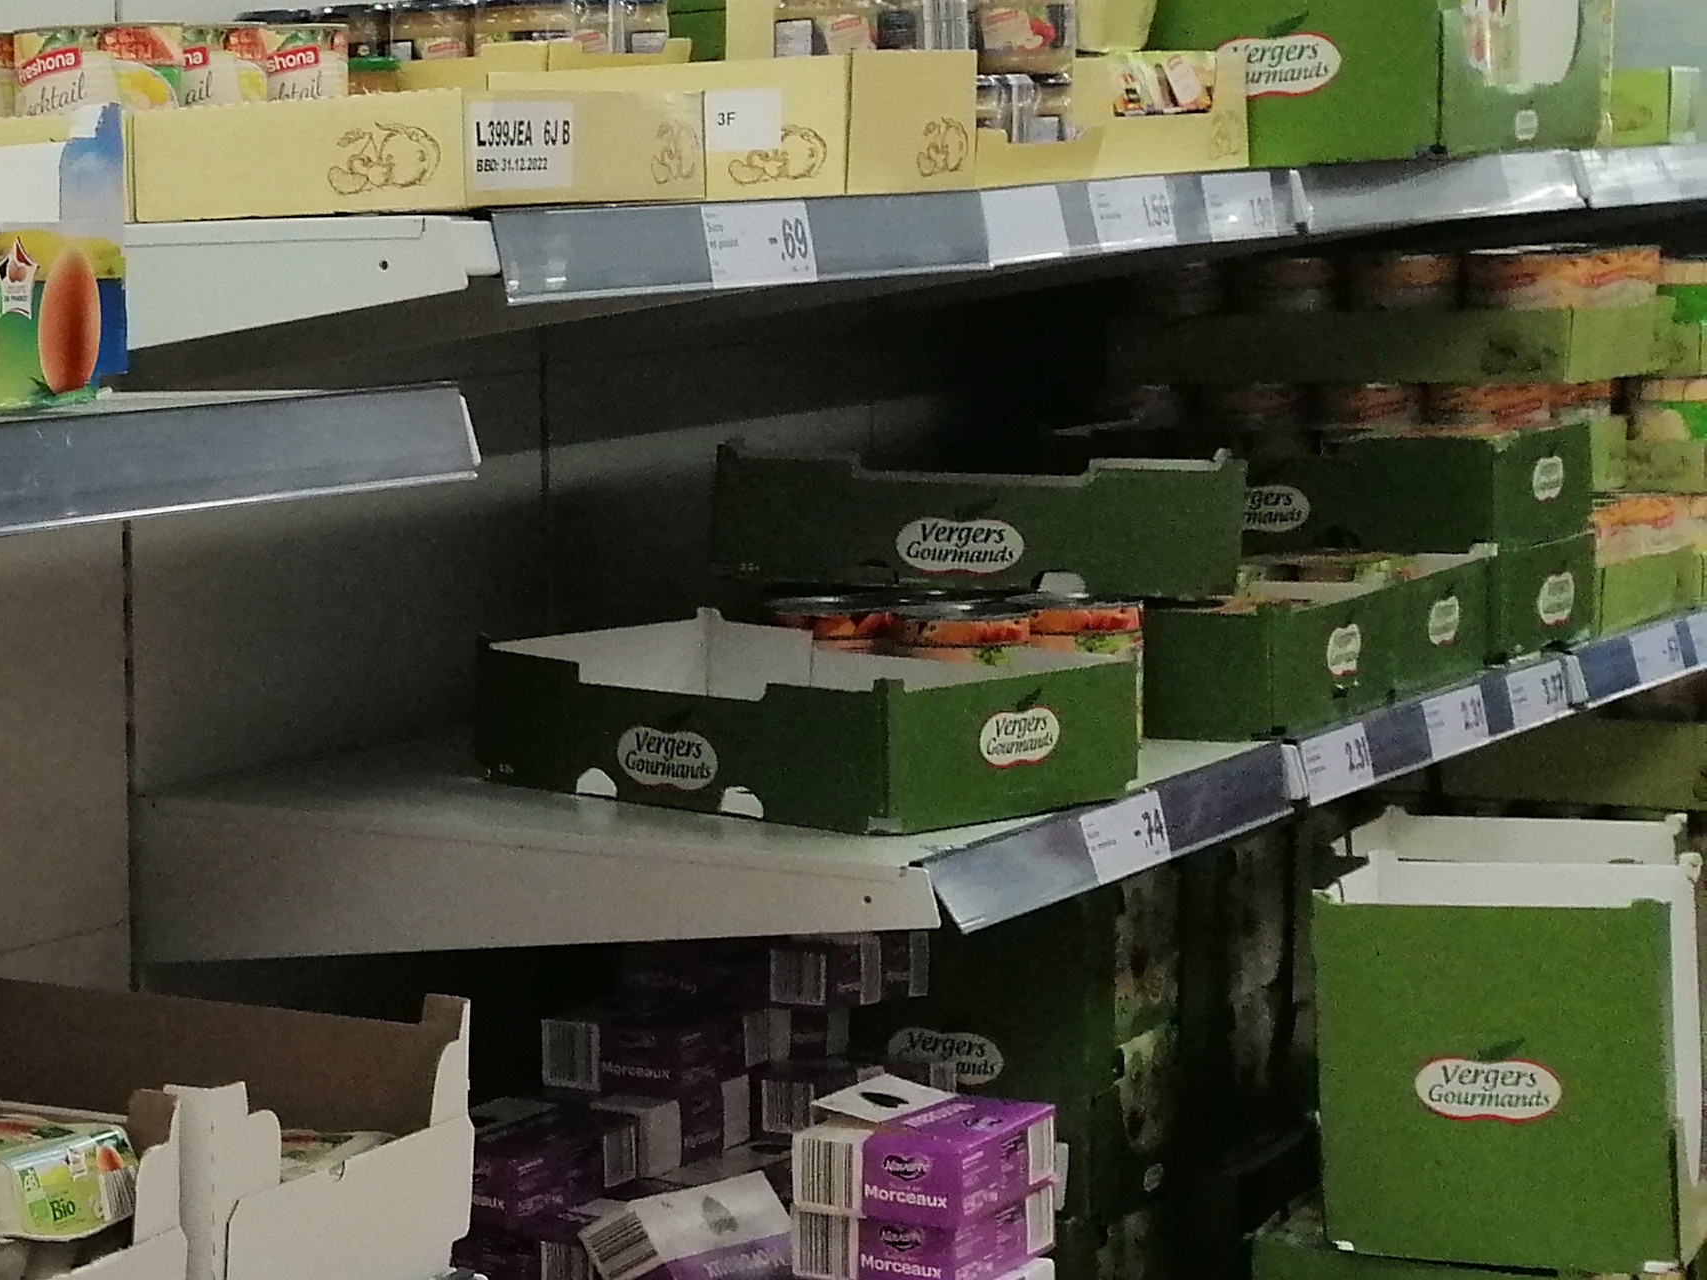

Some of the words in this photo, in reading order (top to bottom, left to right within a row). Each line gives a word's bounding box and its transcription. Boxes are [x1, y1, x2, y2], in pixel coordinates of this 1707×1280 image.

[718, 111, 737, 126] 3F
[768, 218, 808, 261] -.69
[919, 521, 1006, 552] Vergers
[905, 540, 1016, 566] Gourmands
[993, 712, 1049, 740] Vergers
[634, 730, 704, 763] Vergers
[987, 731, 1055, 758] Gourmands
[624, 752, 713, 781] Gourmands
[904, 1030, 986, 1060] Vergers
[1440, 1063, 1538, 1093] Vergers
[1428, 1082, 1552, 1109] Gourmands
[50, 1196, 77, 1224] Bio
[864, 1183, 948, 1209] Morceaux
[860, 1253, 942, 1280] Morceaux
